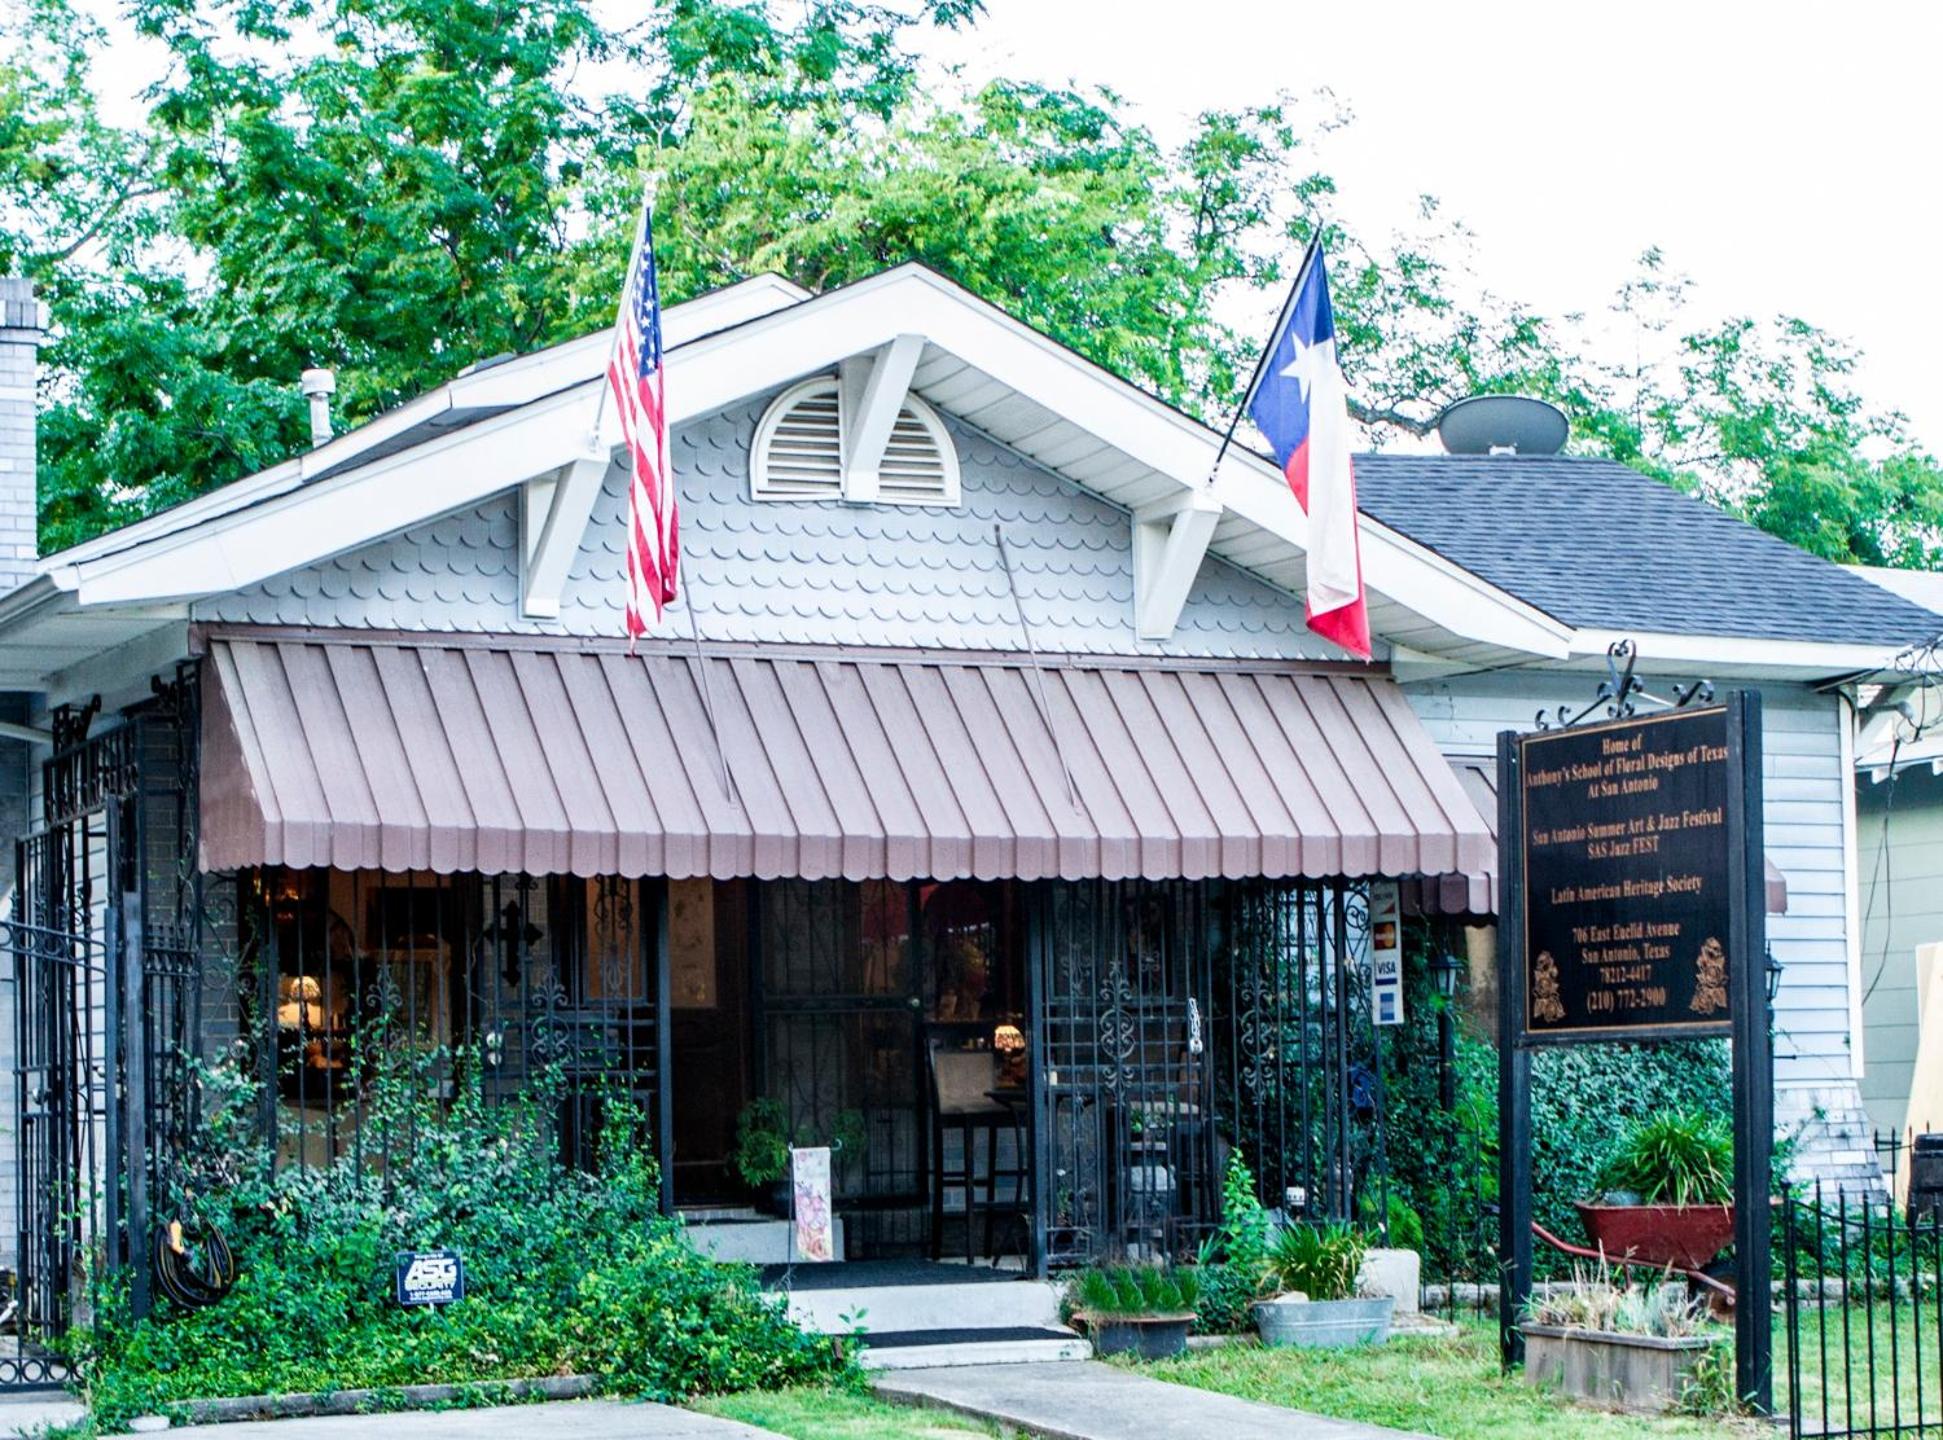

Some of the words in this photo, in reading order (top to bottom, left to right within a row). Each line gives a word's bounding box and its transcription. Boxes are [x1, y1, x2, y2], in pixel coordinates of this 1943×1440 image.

[1603, 739, 1628, 754] Home
[1631, 734, 1641, 750] of
[1572, 762, 1601, 780] School
[1604, 760, 1614, 776] of
[1617, 756, 1644, 773] Floral
[1648, 752, 1684, 770] Designs
[1687, 747, 1698, 763] of
[1700, 746, 1727, 761] Texas
[1588, 784, 1599, 798] At
[1602, 780, 1618, 796] San
[1621, 775, 1658, 793] Antonio
[1533, 831, 1548, 845] San
[1552, 826, 1585, 843] Antonio
[1588, 823, 1625, 839] Summer
[1628, 820, 1644, 833] Art
[1646, 816, 1655, 831] &
[1658, 814, 1680, 830] Jazz
[1683, 808, 1722, 828] Festival
[1588, 842, 1607, 859] SAS
[1609, 842, 1631, 858] Jazz
[1633, 836, 1659, 854] FEST
[1552, 887, 1574, 904] Latin
[1578, 883, 1620, 900] American
[1624, 880, 1664, 898] Heritage
[1667, 875, 1702, 894] Society
[1590, 926, 1610, 941] East
[1613, 923, 1642, 939] Euclid
[1646, 922, 1680, 937] Avenue
[1582, 948, 1599, 963] San
[1602, 944, 1641, 961] Antonio,
[1643, 943, 1670, 959] Texas
[1377, 961, 1396, 974] VISA
[1588, 991, 1615, 1014] (210)
